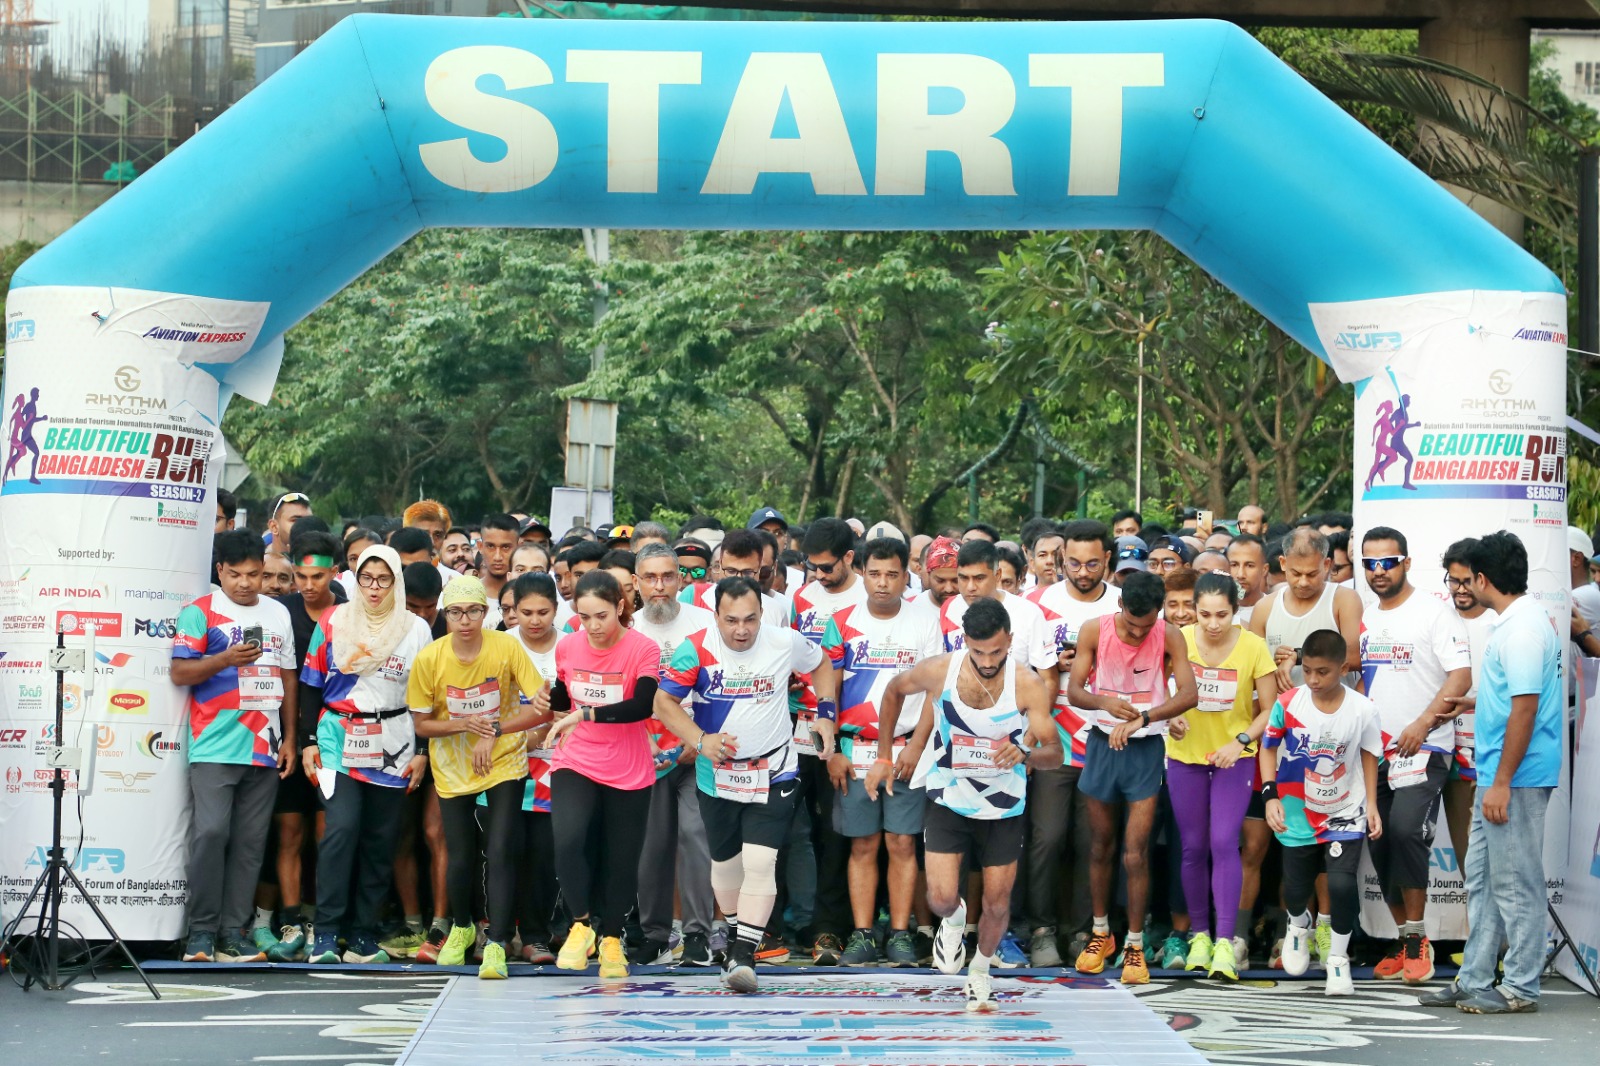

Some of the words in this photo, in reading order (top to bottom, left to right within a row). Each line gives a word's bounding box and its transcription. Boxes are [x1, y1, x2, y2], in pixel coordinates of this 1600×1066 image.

[419, 45, 1164, 196] START
[143, 326, 200, 342] AVIATION
[197, 332, 247, 343] EXPRESS
[1512, 327, 1552, 342] AVIATION
[85, 394, 167, 409] RHYTHM
[1461, 399, 1536, 410] RHYTHM
[107, 407, 147, 416] GROUP
[75, 417, 87, 425] And
[89, 417, 116, 426] Tourism
[116, 419, 153, 429] Journalists
[153, 421, 171, 430] Forum
[1493, 423, 1525, 431] Journalists
[43, 427, 151, 455] BEAUTIFUL
[1418, 433, 1524, 457] BEAUTIFUL
[145, 433, 205, 485] RUN
[1521, 435, 1564, 484] RUN
[38, 454, 145, 479] BANGLADESH
[1413, 460, 1519, 481] BANGLADESH
[150, 484, 202, 502] SEASON-2
[1526, 486, 1564, 501] SEASON-2
[58, 548, 101, 559] Supported
[102, 549, 115, 561] by:
[39, 587, 60, 597] AIR
[64, 588, 101, 598] INDIA
[254, 682, 274, 690] 7007
[1197, 682, 1219, 693] 7121
[584, 688, 606, 698] 7255
[461, 699, 485, 710] 7160
[0, 730, 27, 742] CR
[156, 741, 181, 750] FAMOUS
[347, 740, 370, 748] 7108
[728, 775, 752, 784] 7093
[6, 785, 20, 793] FSH
[1316, 787, 1338, 797] 7220
[4, 876, 33, 886] Tourism
[85, 879, 114, 889] Forum
[116, 879, 126, 889] of
[1433, 878, 1464, 889] Journa
